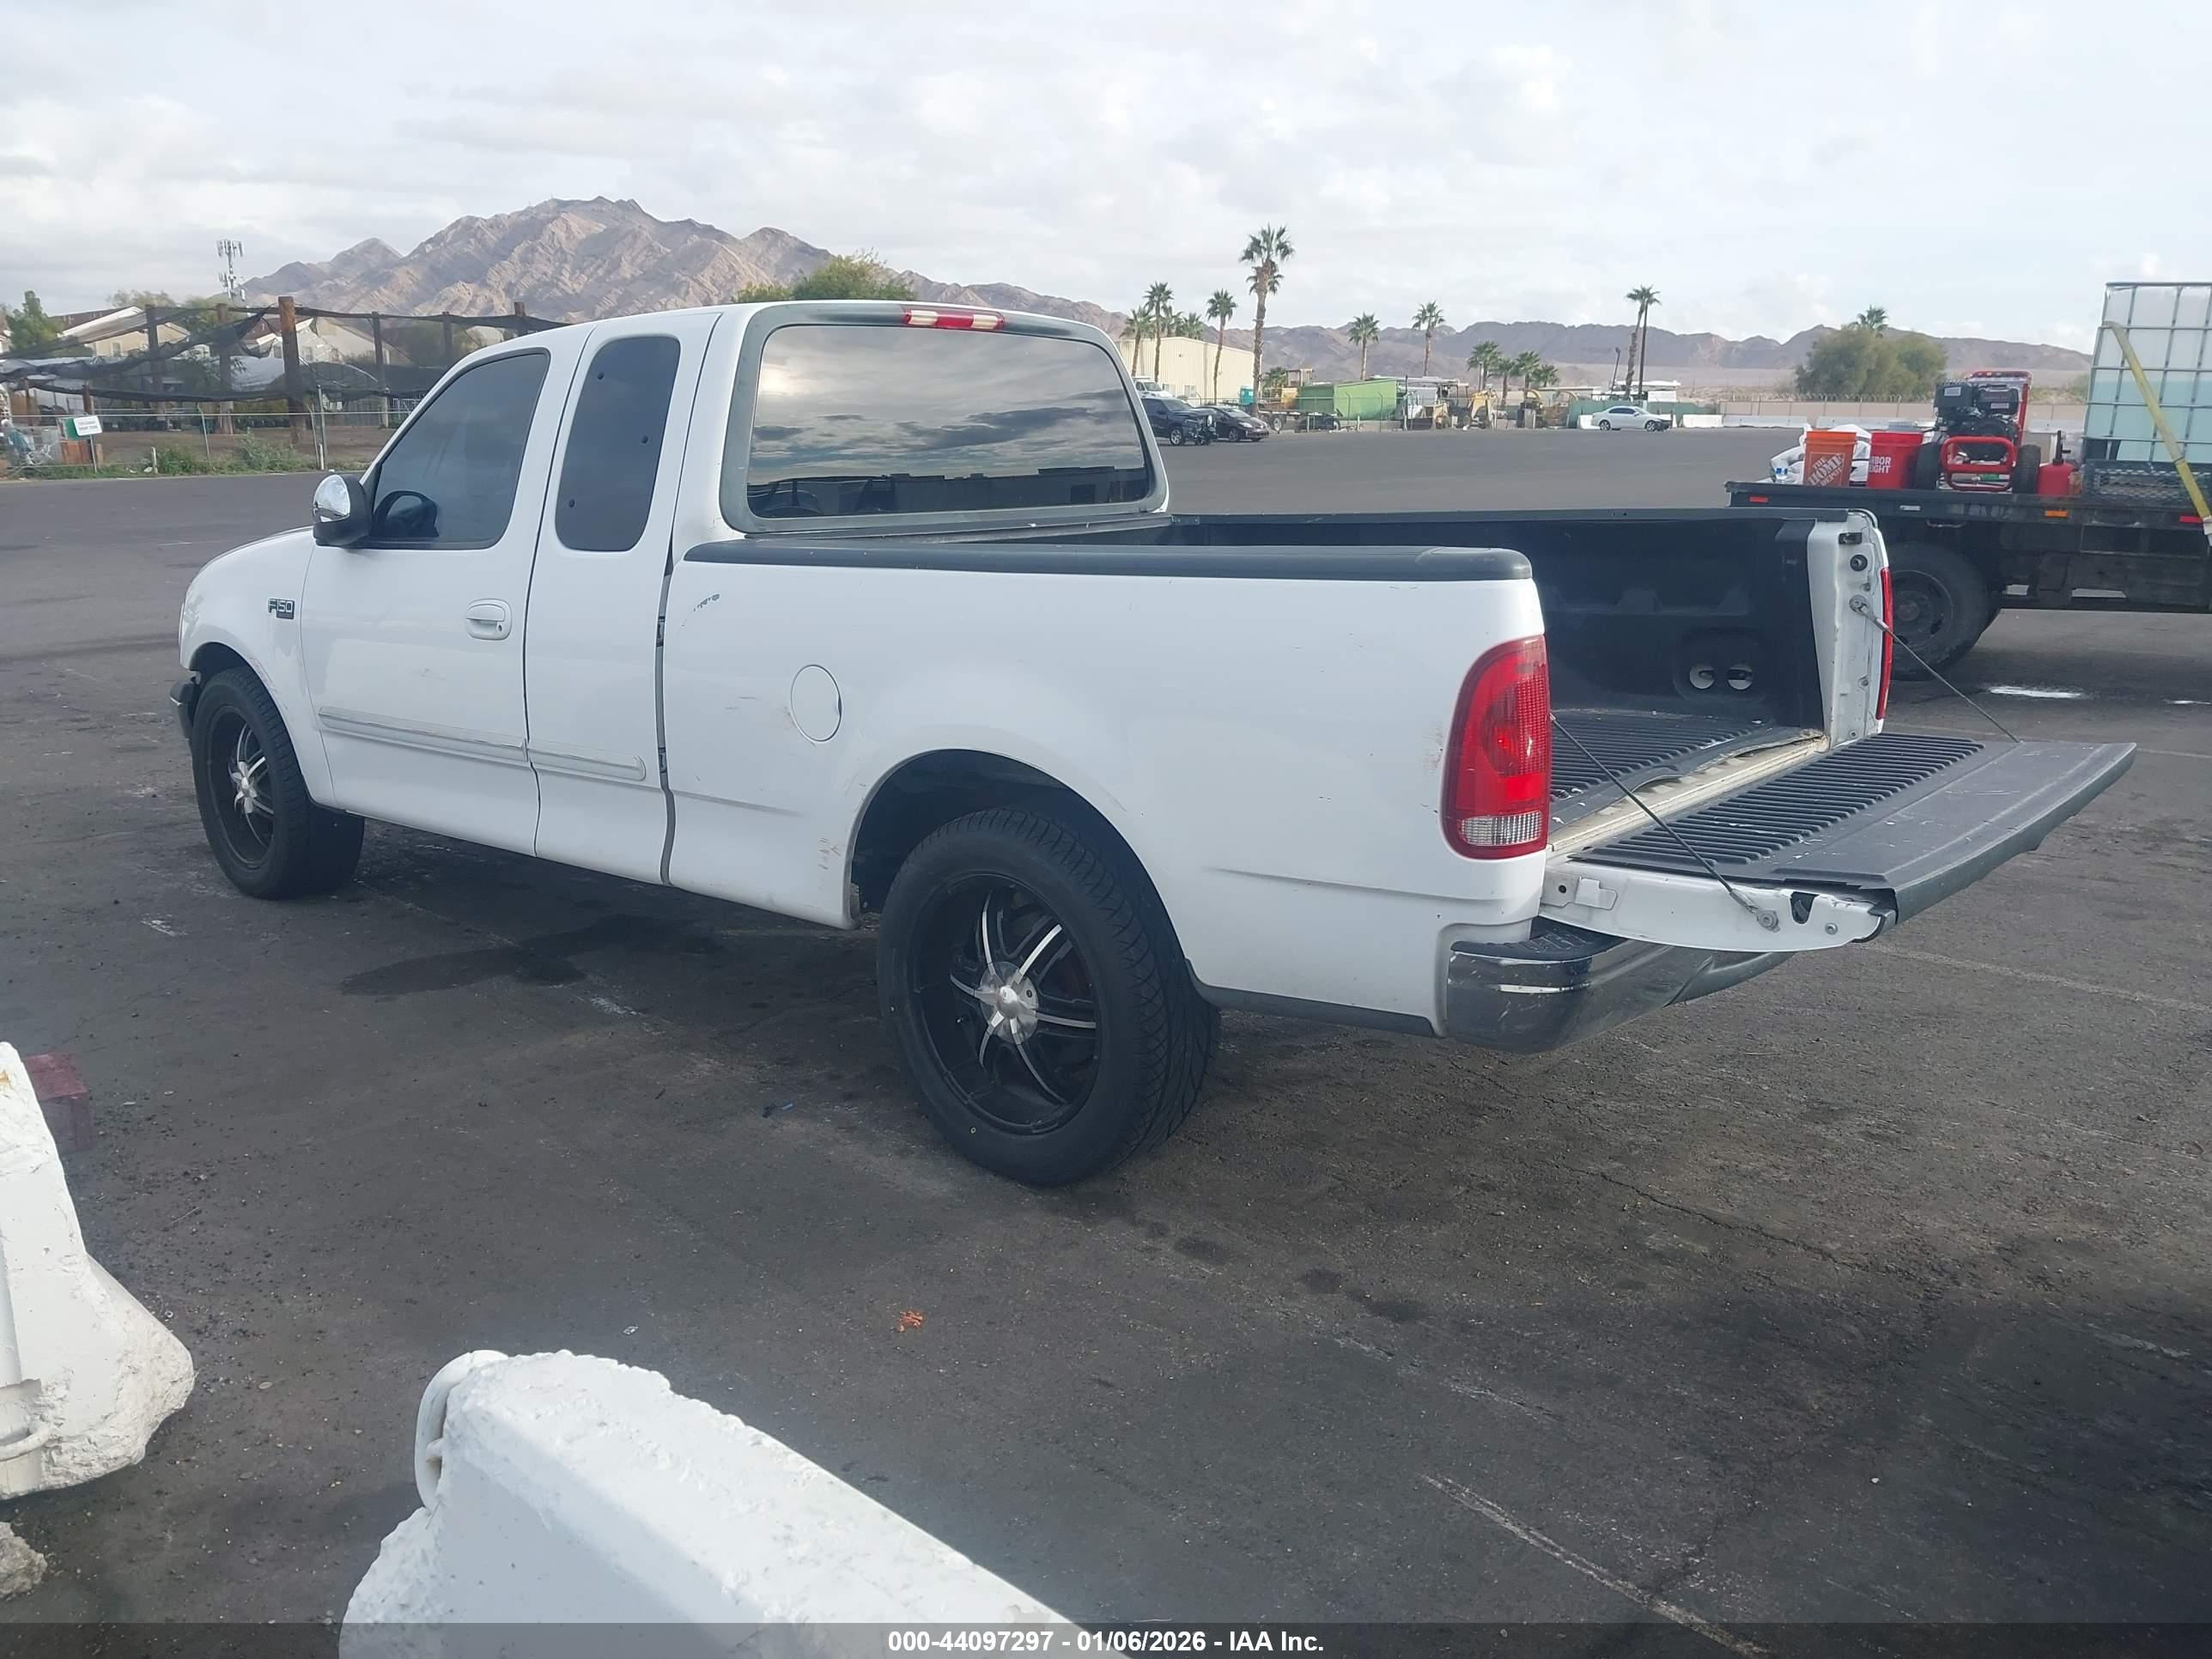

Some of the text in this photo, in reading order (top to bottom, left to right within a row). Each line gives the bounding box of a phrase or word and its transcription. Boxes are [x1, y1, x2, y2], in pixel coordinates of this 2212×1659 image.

[1813, 457, 1827, 469] THE
[1870, 456, 1891, 465] RBOR
[1808, 454, 1842, 485] HOME
[1869, 465, 1891, 473] EIGHT
[1820, 467, 1842, 487] DEPOT
